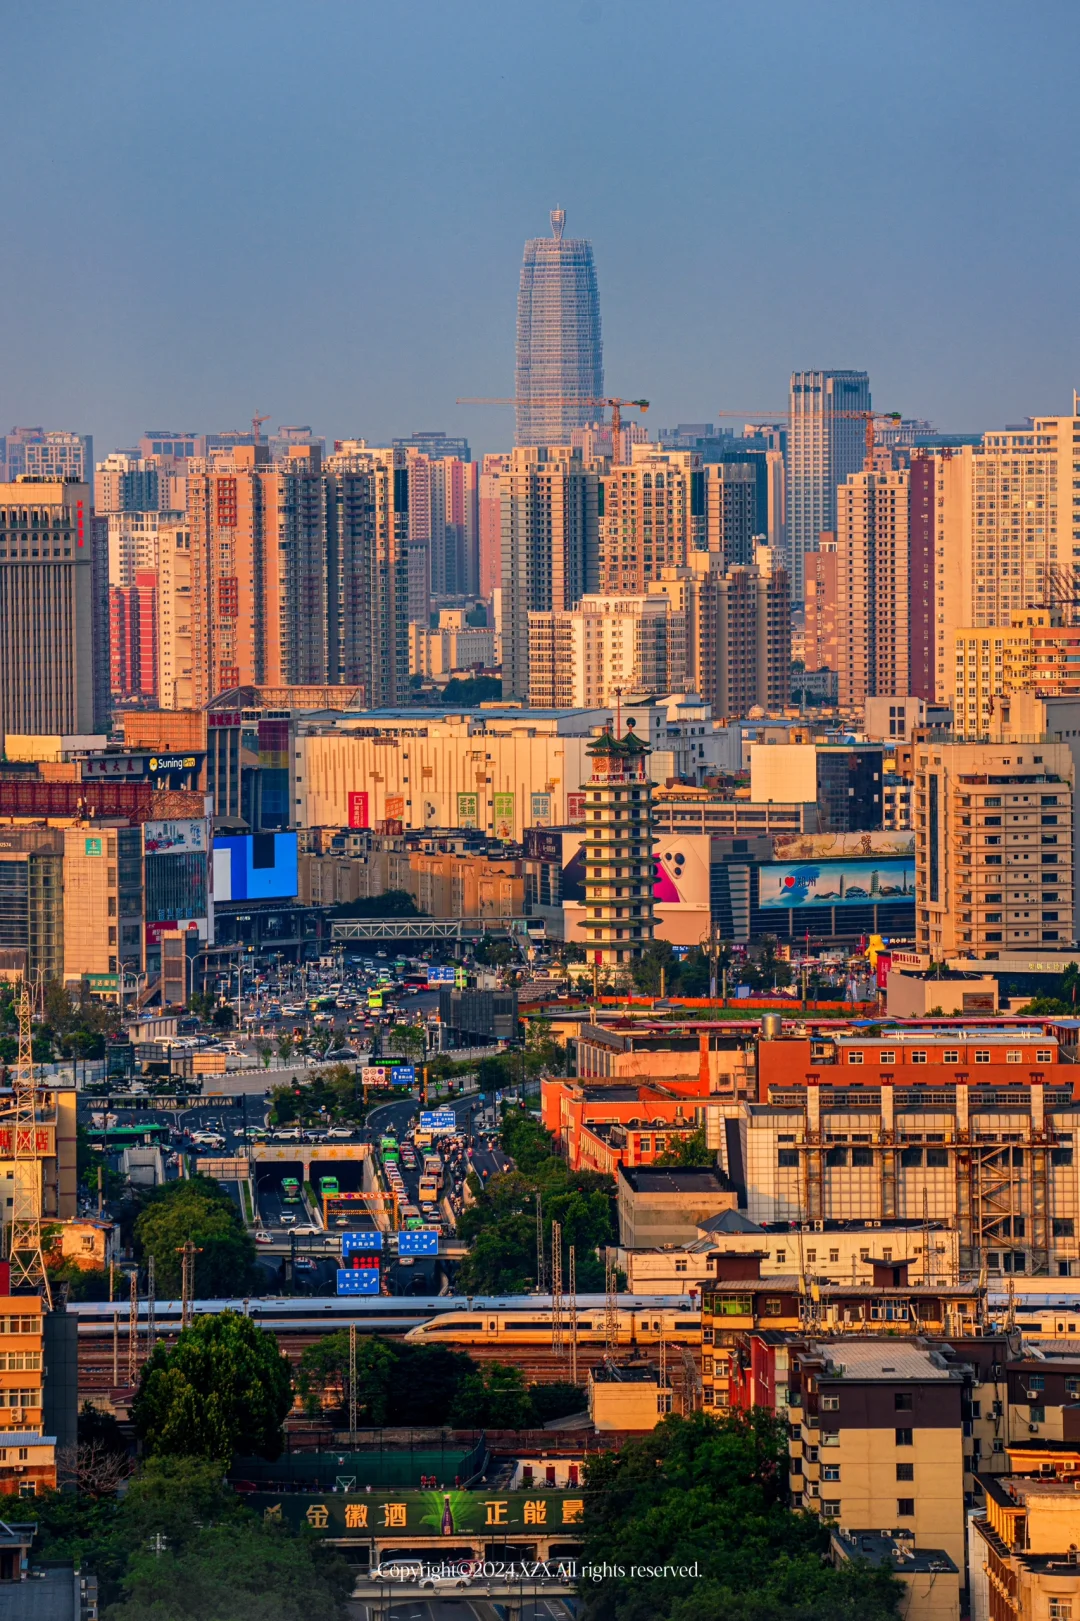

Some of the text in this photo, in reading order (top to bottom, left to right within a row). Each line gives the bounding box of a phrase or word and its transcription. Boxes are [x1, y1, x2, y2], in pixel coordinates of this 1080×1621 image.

[158, 757, 196, 774] Suning Pro
[798, 876, 817, 888] 郑州
[306, 1500, 585, 1529] 金徽酒 正能量
